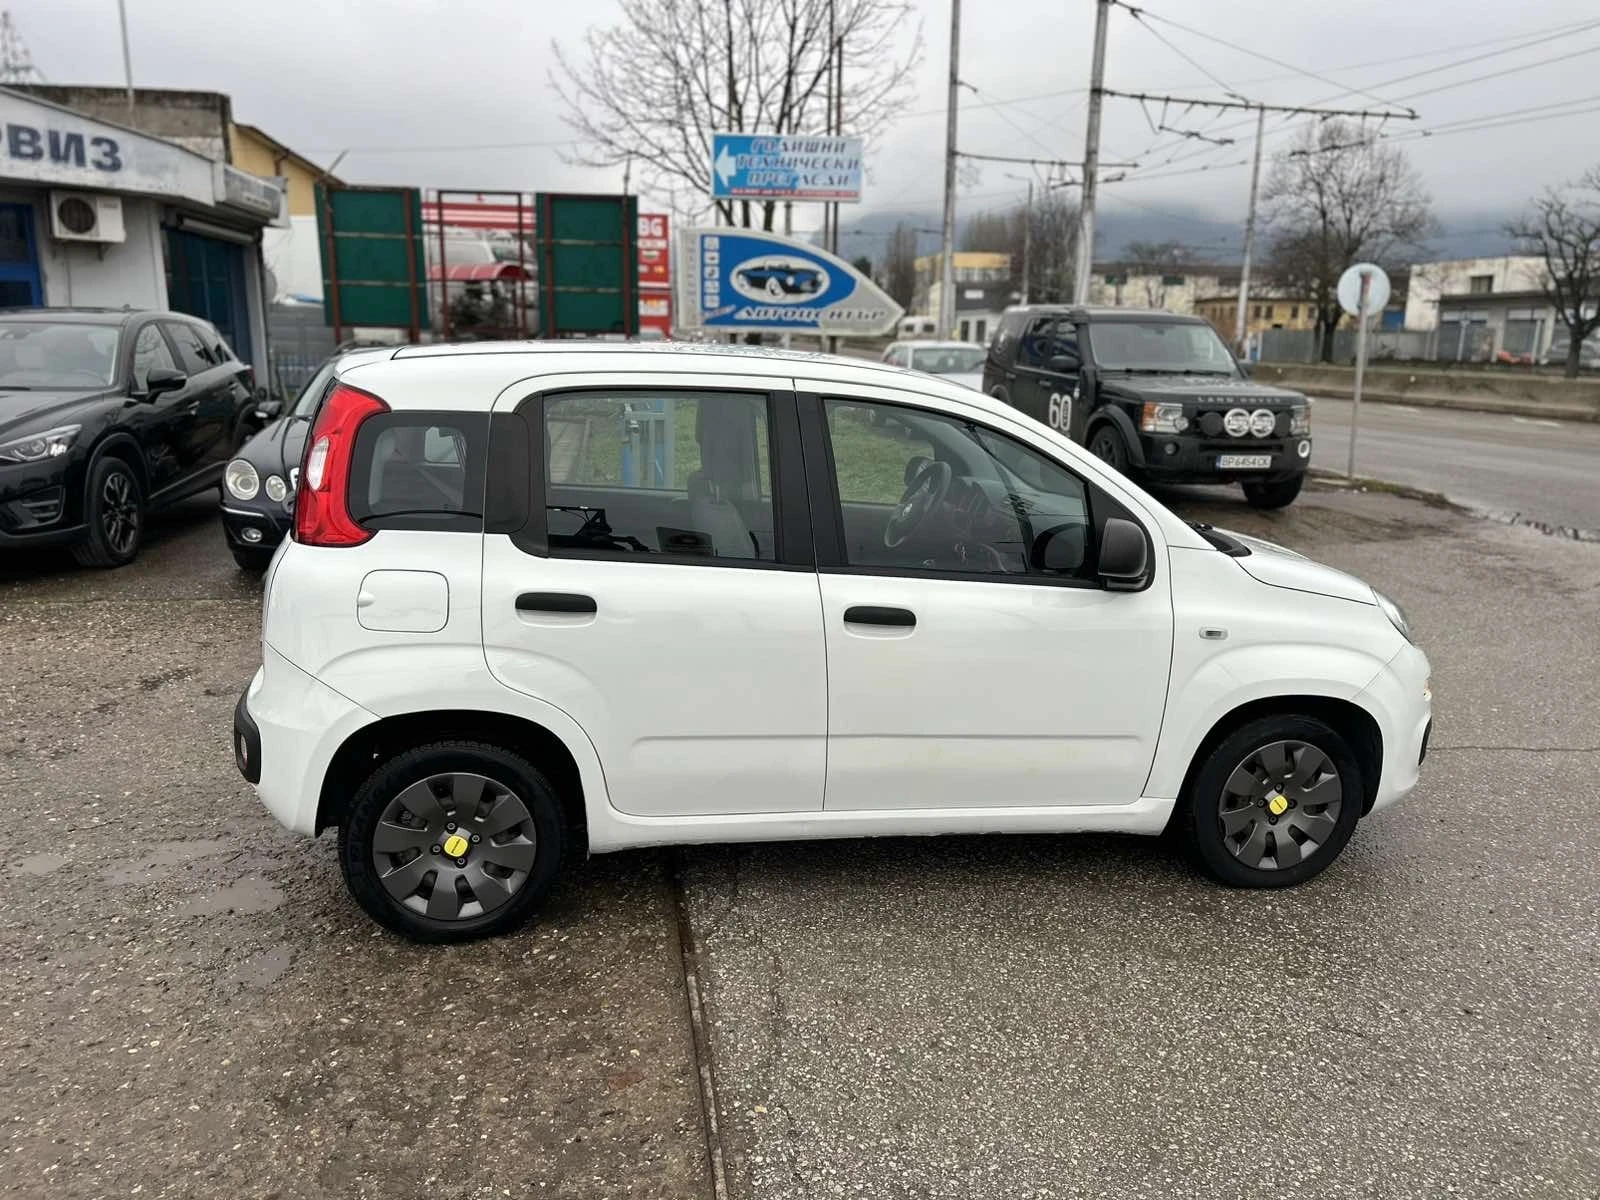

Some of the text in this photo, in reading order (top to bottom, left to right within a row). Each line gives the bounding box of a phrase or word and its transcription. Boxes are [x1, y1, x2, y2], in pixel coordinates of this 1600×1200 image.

[0, 122, 123, 173] ВИЗ
[737, 156, 859, 170] ТЕХНИЧЕСКИ
[1049, 392, 1072, 431] 60
